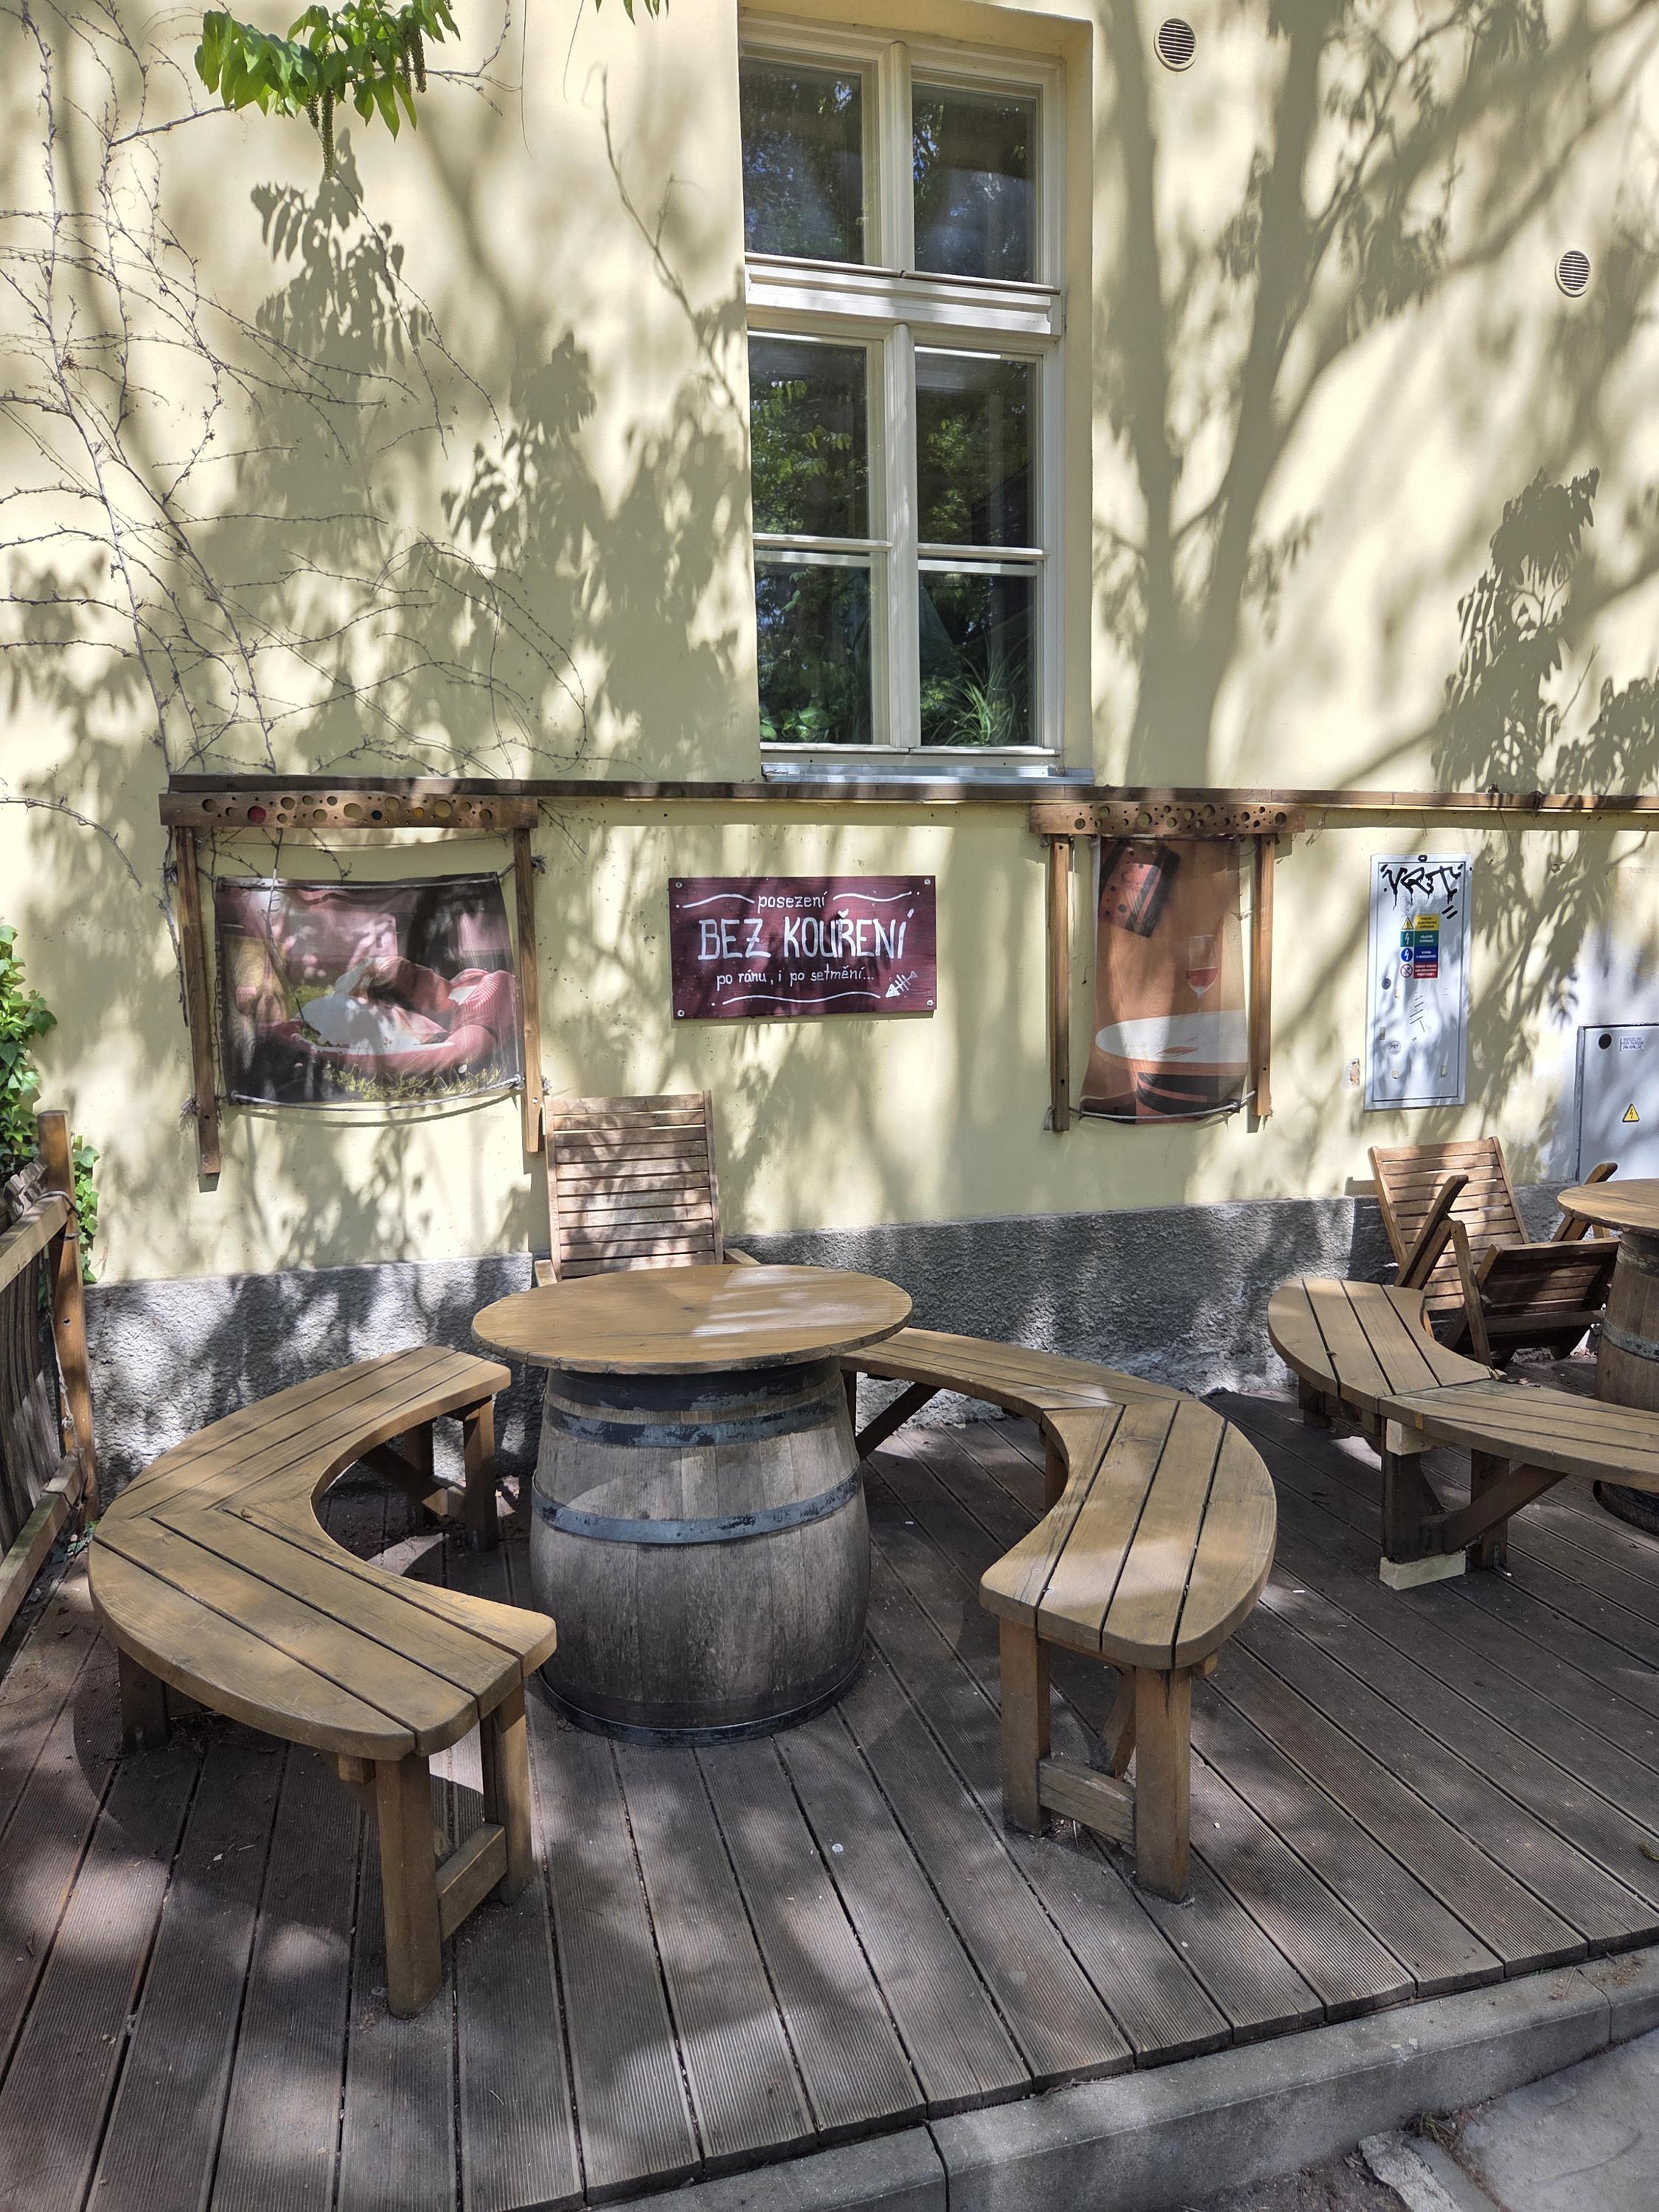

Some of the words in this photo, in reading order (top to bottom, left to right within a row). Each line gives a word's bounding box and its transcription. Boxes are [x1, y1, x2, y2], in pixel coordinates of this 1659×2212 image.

[757, 891, 828, 914] posezení
[698, 918, 771, 960] BEZ
[783, 908, 915, 959] KOUŘENÍ
[717, 973, 733, 991] po
[778, 969, 782, 982] i
[790, 971, 805, 987] po
